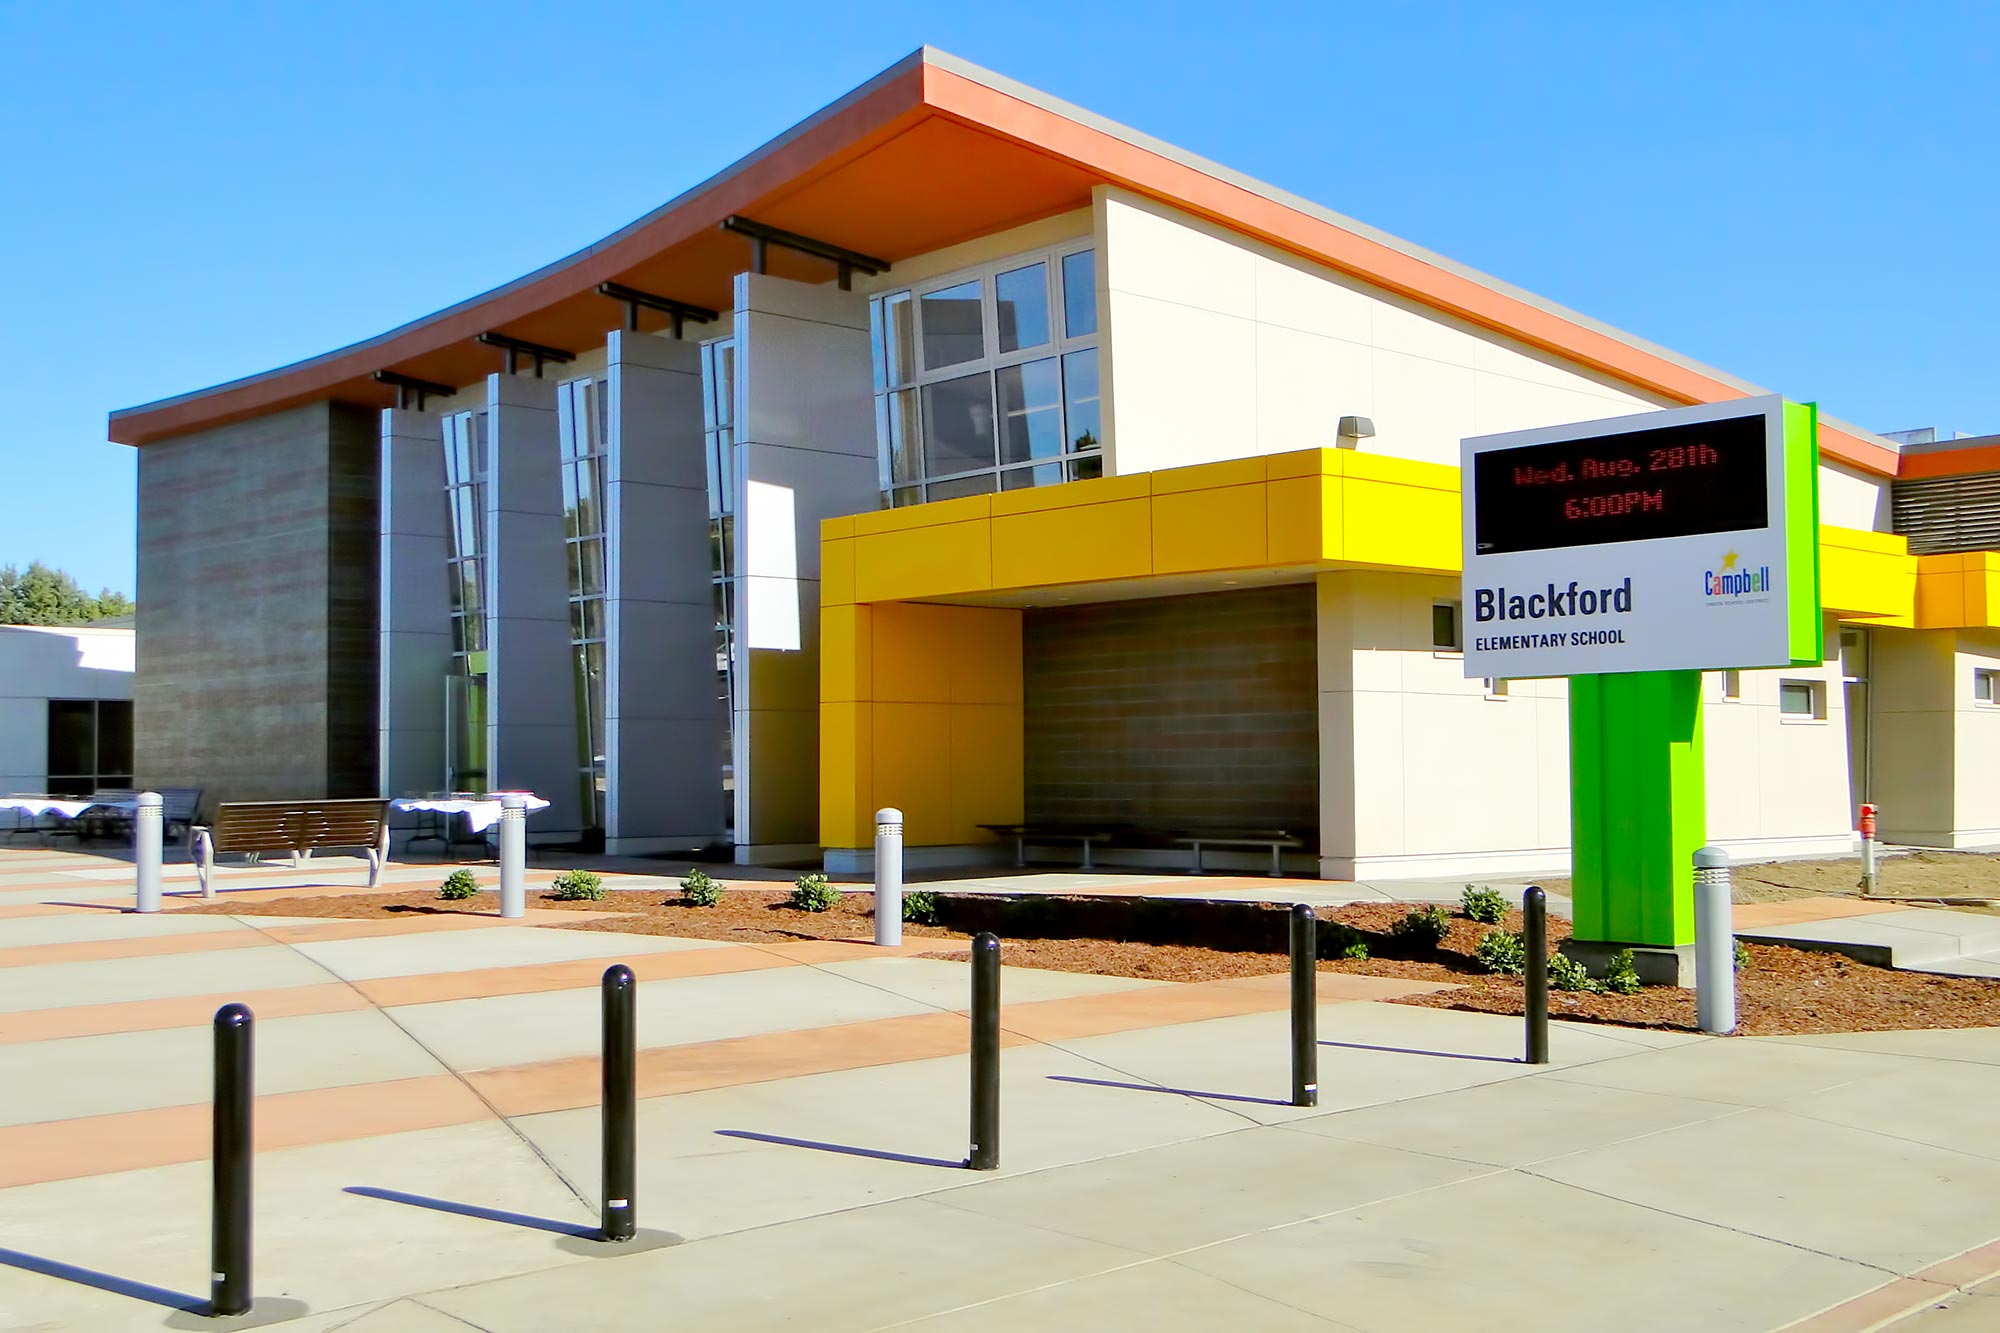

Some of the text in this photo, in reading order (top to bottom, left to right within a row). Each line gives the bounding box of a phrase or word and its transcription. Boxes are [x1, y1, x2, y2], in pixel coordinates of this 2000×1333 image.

[1514, 444, 1718, 485] Wed. Aug. 28th
[1564, 489, 1663, 519] 6:00PM
[1704, 566, 1769, 598] Campbell
[1475, 577, 1632, 622] Blackford
[1476, 629, 1625, 651] ELEMENTARY SCHOOL
